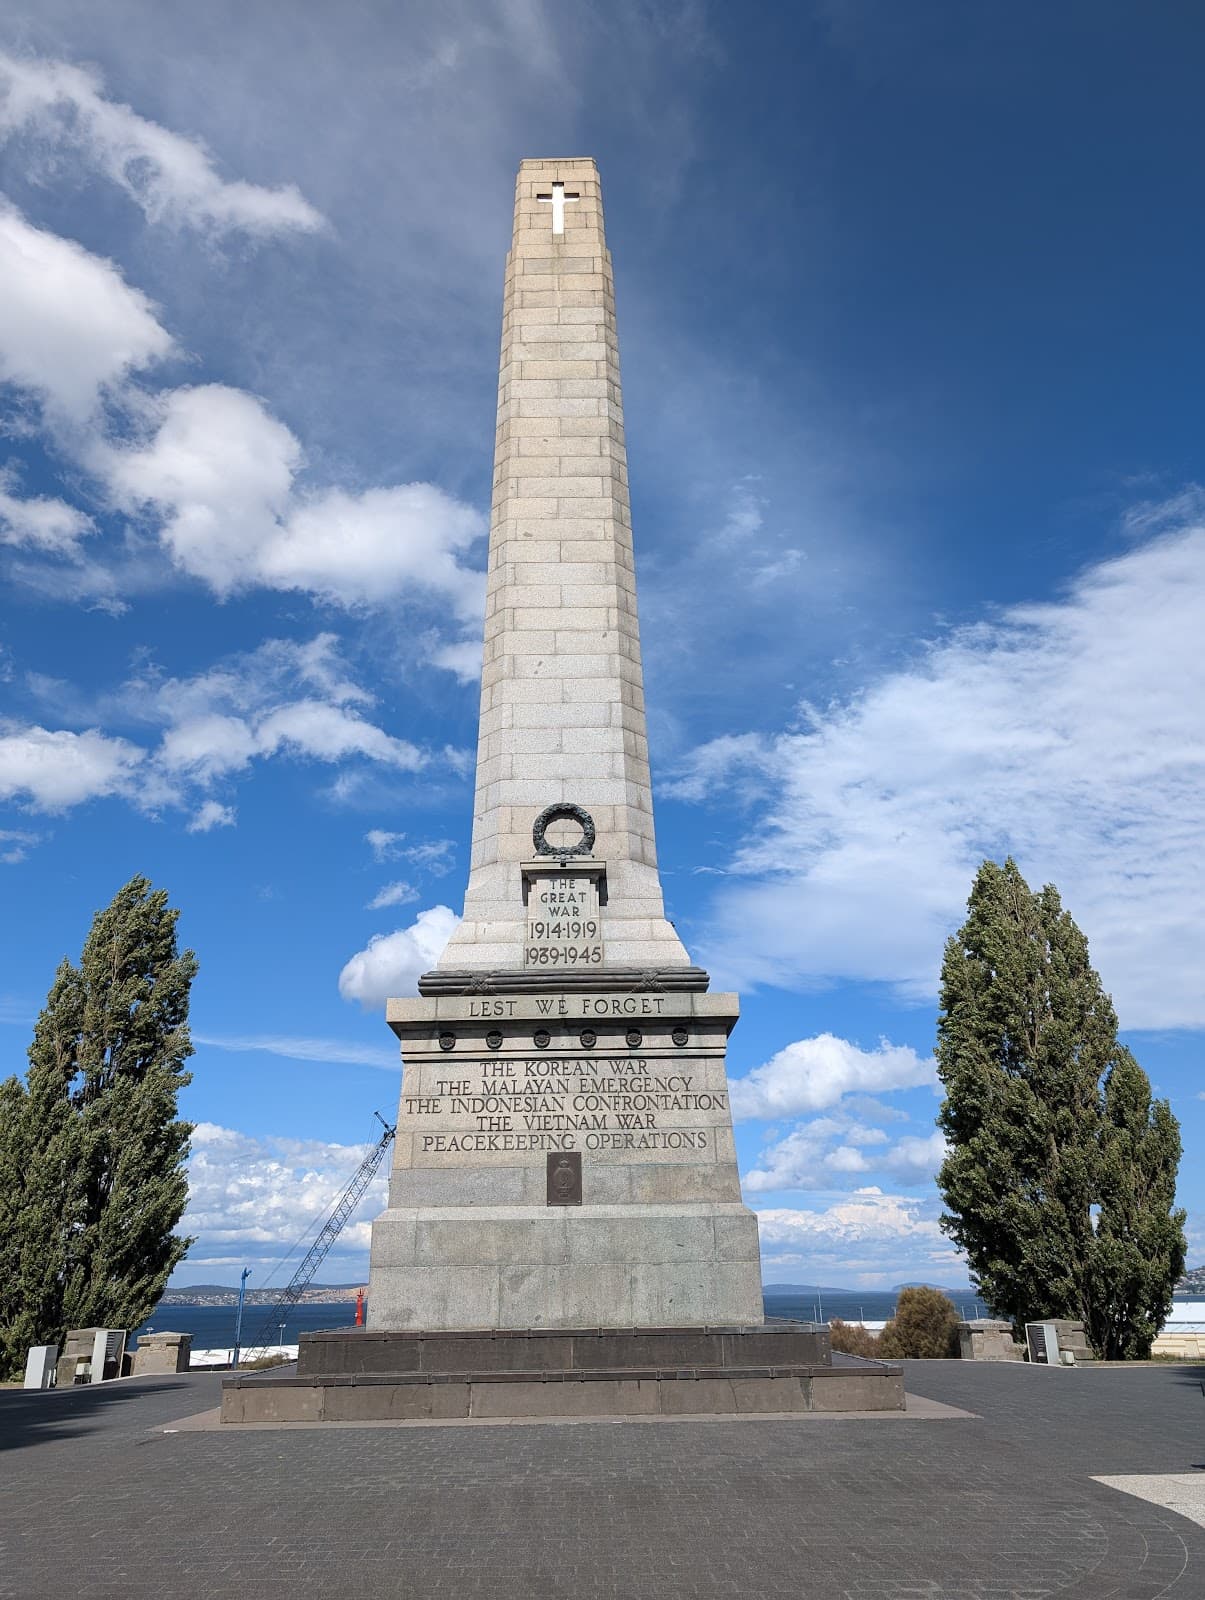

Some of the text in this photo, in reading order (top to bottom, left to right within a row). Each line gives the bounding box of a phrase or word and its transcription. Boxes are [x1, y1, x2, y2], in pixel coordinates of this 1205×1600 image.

[550, 879, 576, 889] THE
[540, 892, 586, 903] GREAT
[548, 906, 580, 917] WAR
[525, 946, 601, 965] 1939-1945
[469, 998, 665, 1017] LEST WE FORGET
[480, 1059, 649, 1077] THE KOREAN WAR
[436, 1076, 693, 1096] THE MALAYAN EMERGENCY
[406, 1094, 726, 1114] THE INDONESIAN CONFRONTATION
[476, 1113, 658, 1131] THE VIETNAM WAR
[421, 1131, 707, 1151] PEACEKEEPING OPERATIONS
